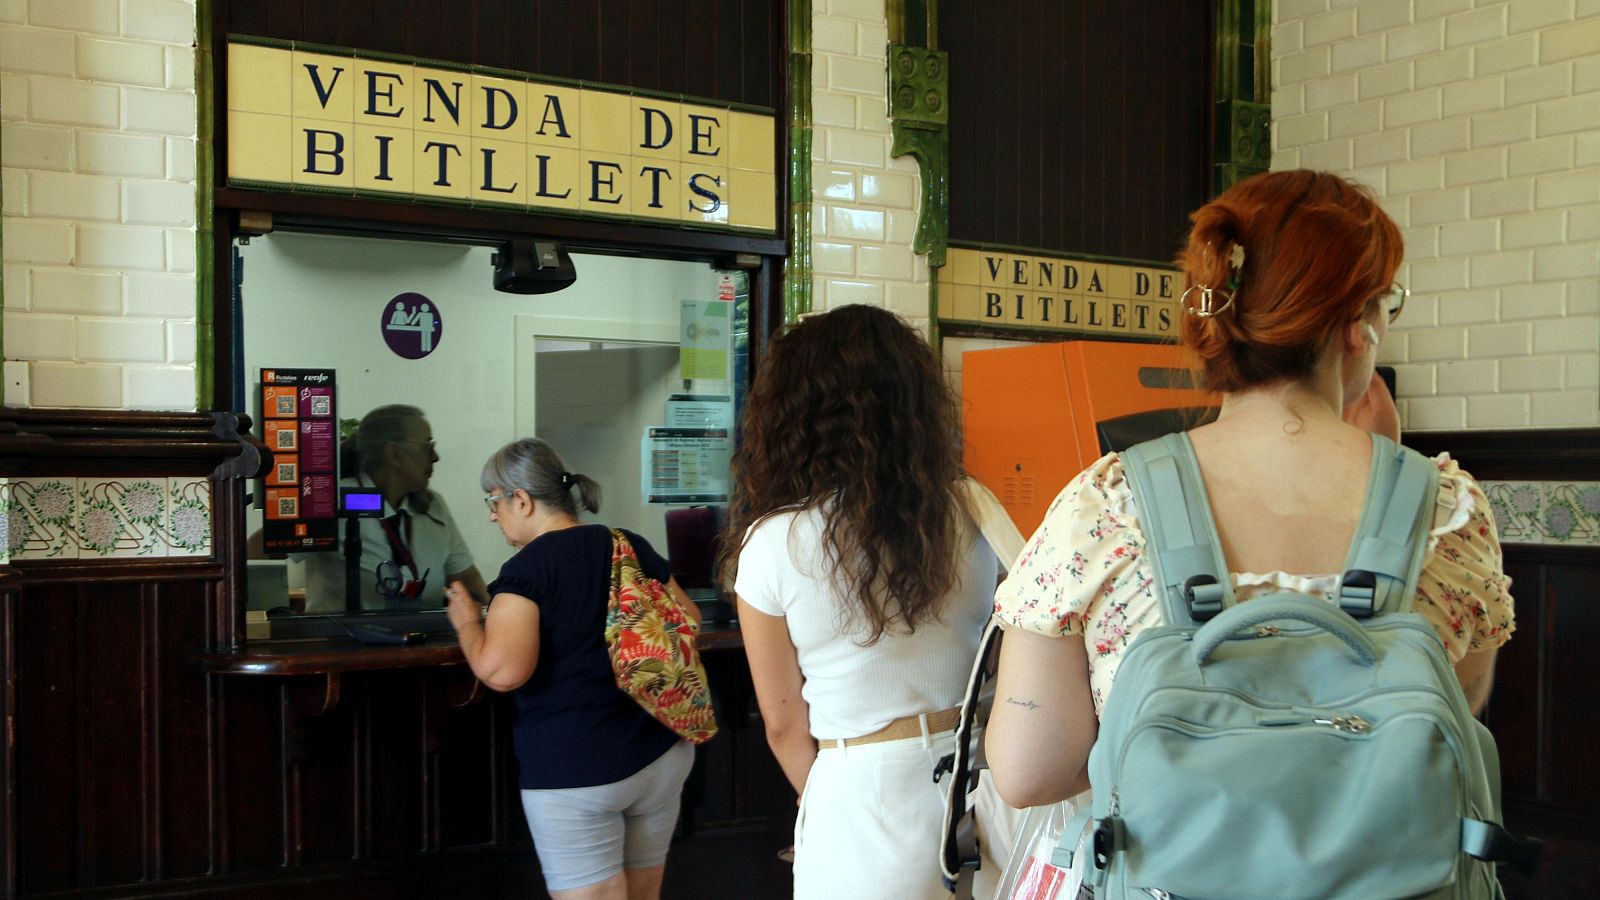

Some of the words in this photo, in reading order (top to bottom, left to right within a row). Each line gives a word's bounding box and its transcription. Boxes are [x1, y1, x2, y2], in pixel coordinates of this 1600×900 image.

[303, 64, 571, 138] VENDA
[639, 107, 721, 157] DE
[303, 128, 722, 214] BITLLETS
[985, 257, 1104, 292] VENDA
[1135, 272, 1173, 299] DE
[985, 292, 1171, 332] BITLLETS
[303, 373, 329, 383] renfe
